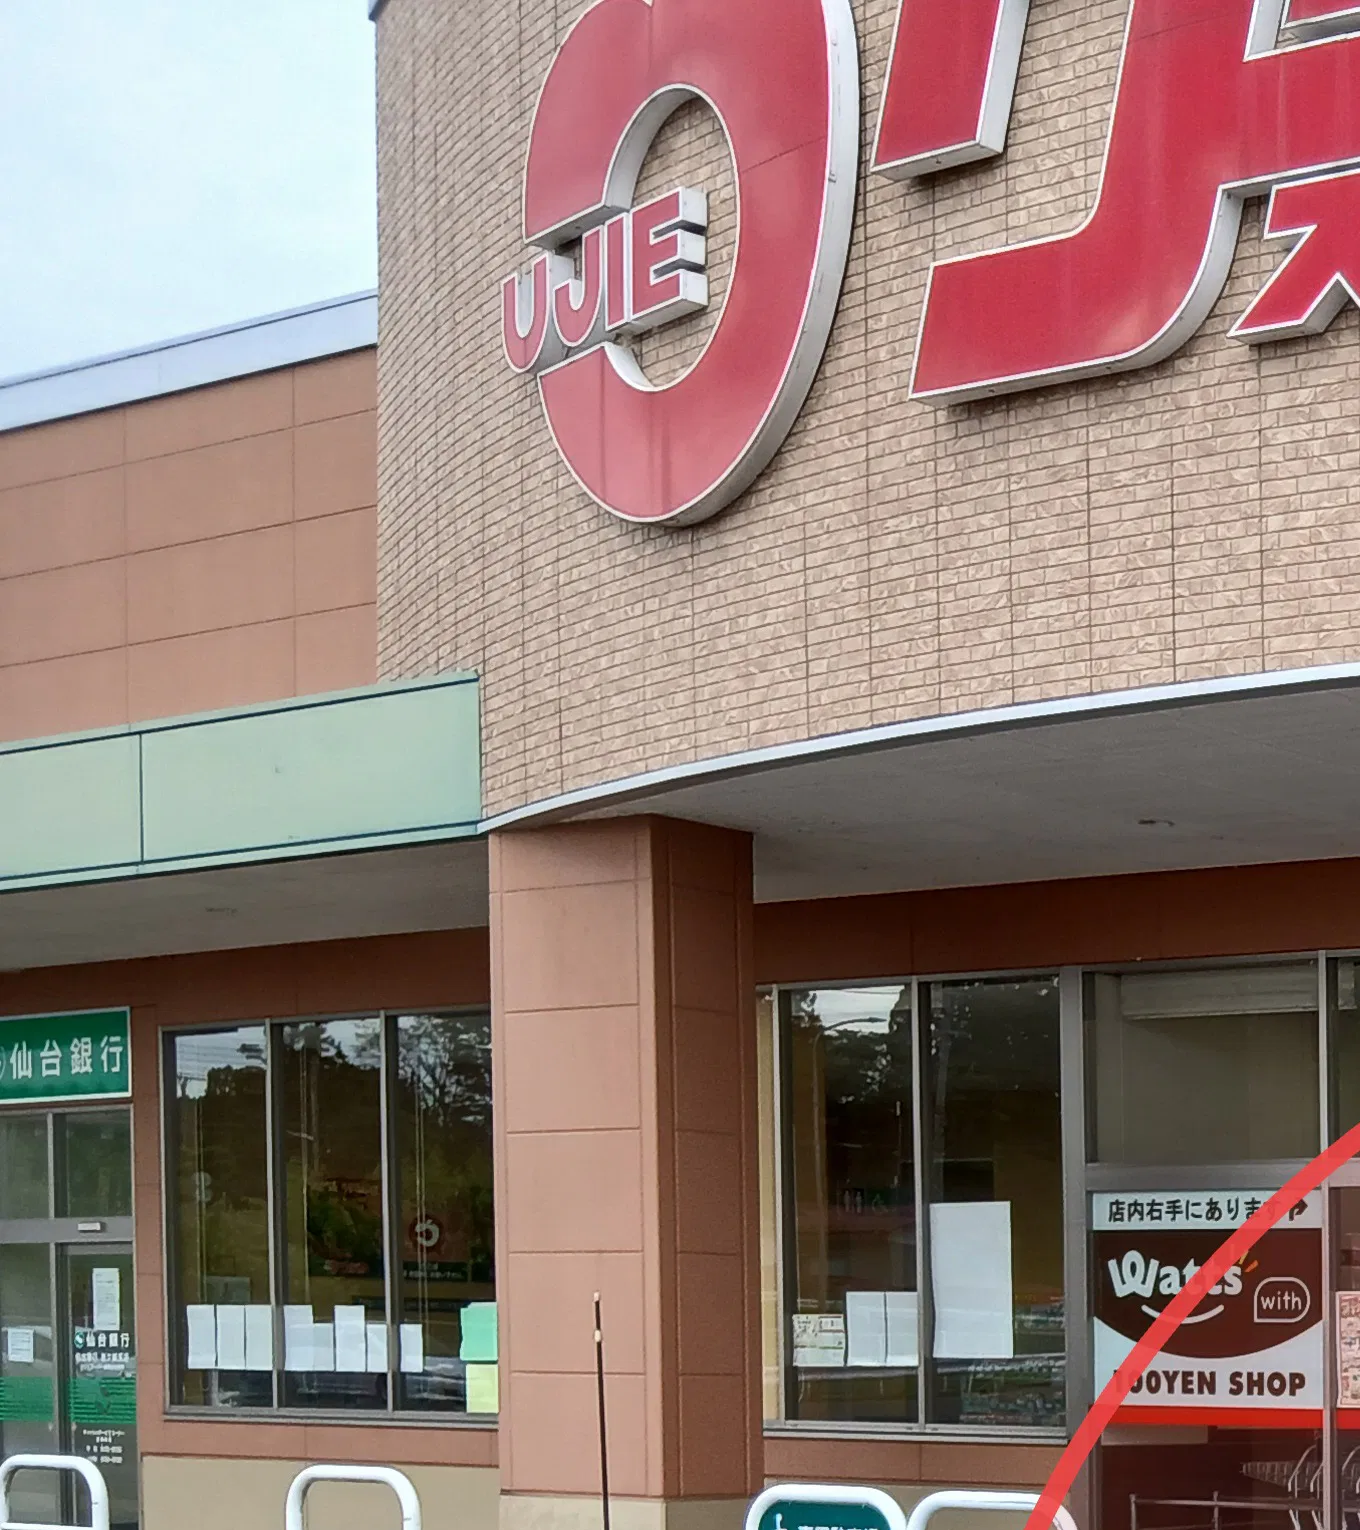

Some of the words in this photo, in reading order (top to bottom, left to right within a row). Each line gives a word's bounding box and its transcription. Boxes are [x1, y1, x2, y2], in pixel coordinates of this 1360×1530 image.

[502, 187, 707, 374] UJIE
[9, 1035, 124, 1080] 仙台銀行
[1260, 1290, 1302, 1311] with
[1229, 1371, 1306, 1396] SHOP
